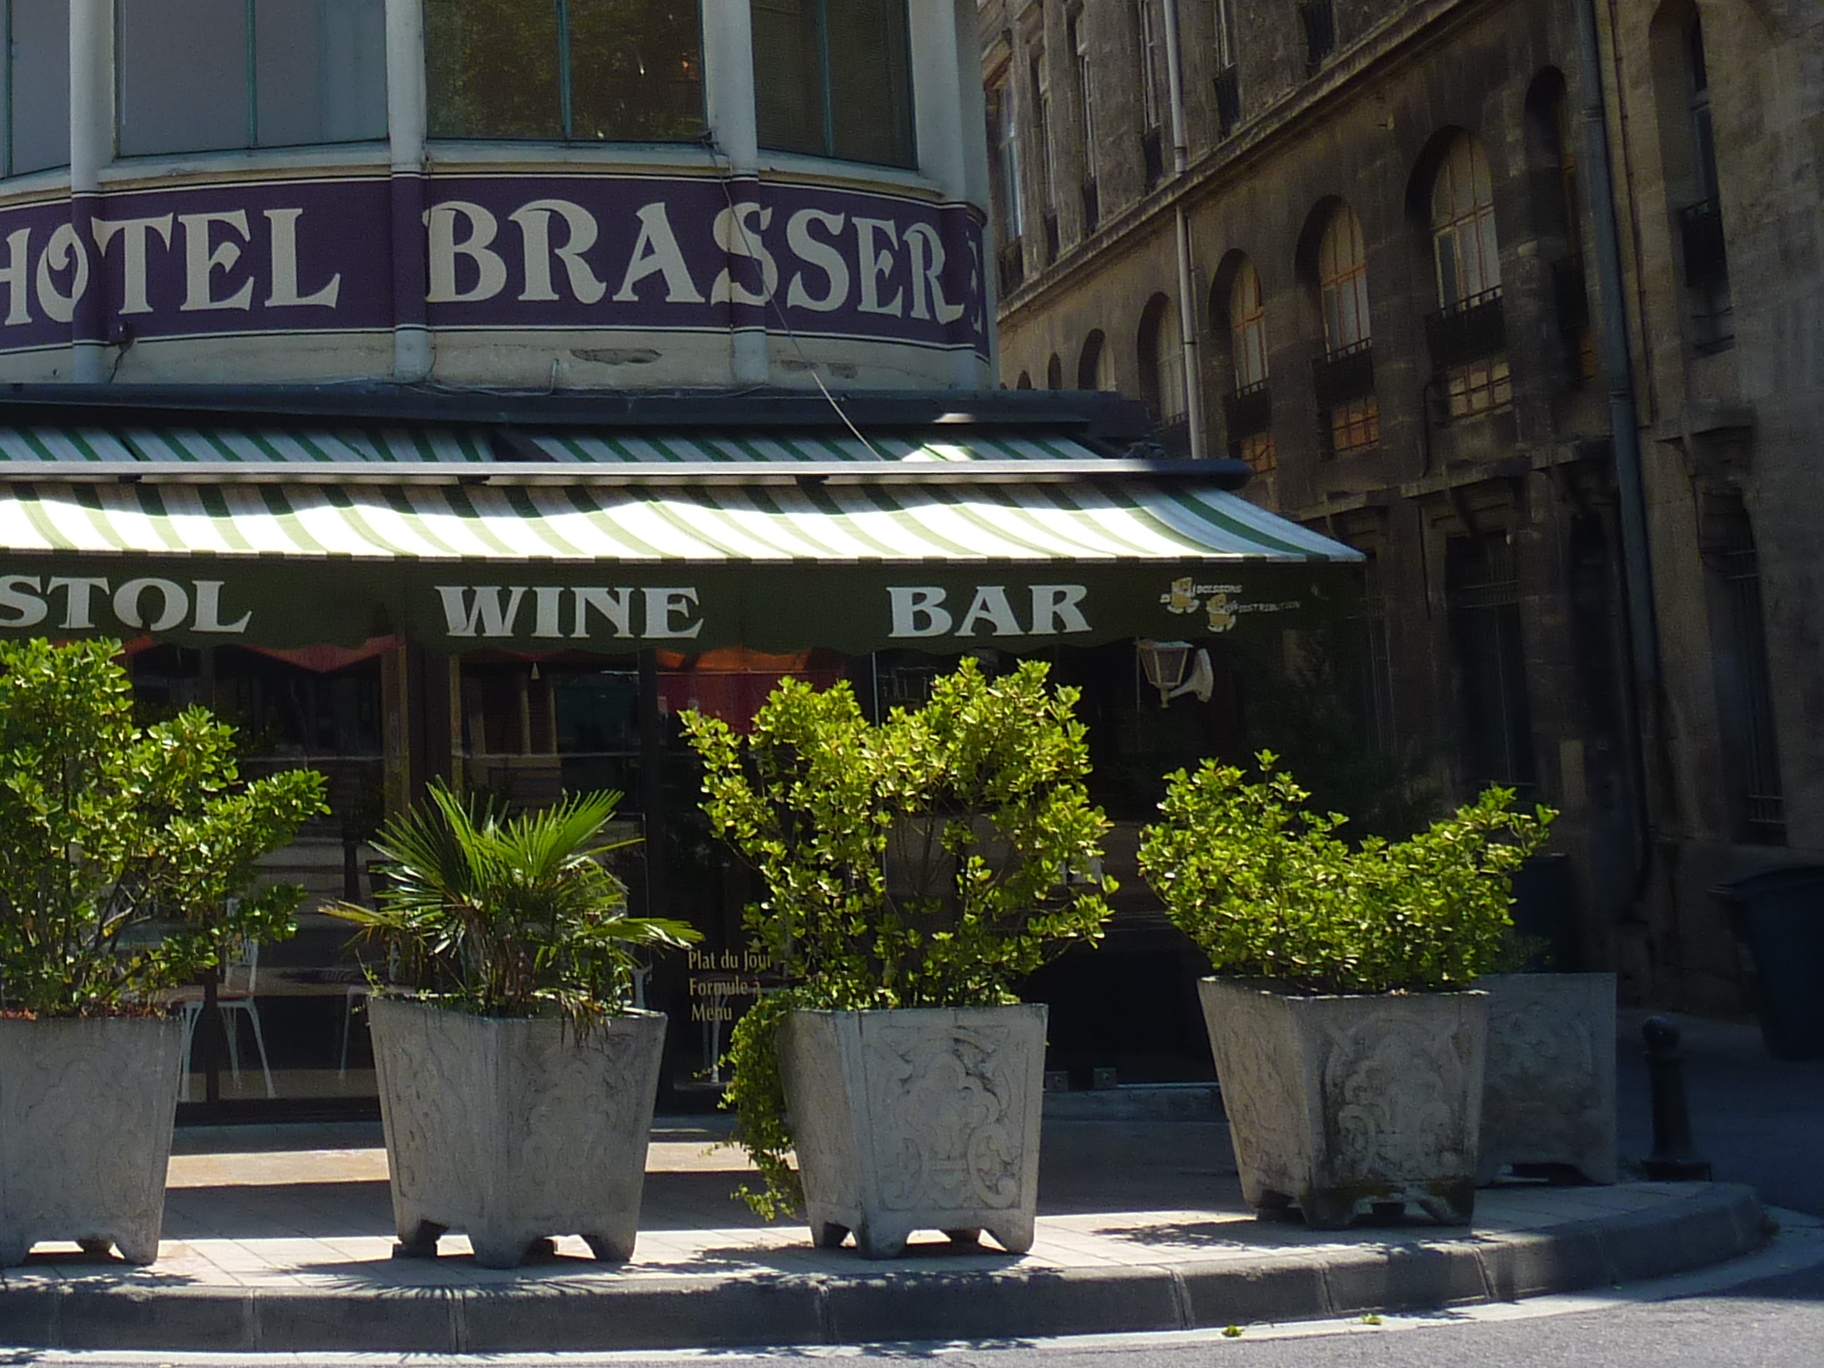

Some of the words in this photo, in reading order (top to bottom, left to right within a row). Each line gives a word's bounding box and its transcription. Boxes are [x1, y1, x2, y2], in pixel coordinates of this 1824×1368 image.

[422, 199, 983, 334] BRASSER
[434, 586, 704, 639] WINE
[887, 585, 1092, 638] BAR
[688, 949, 716, 970] Plat
[720, 949, 738, 969] du
[689, 975, 748, 996] Formule
[691, 1003, 732, 1021] Menu
